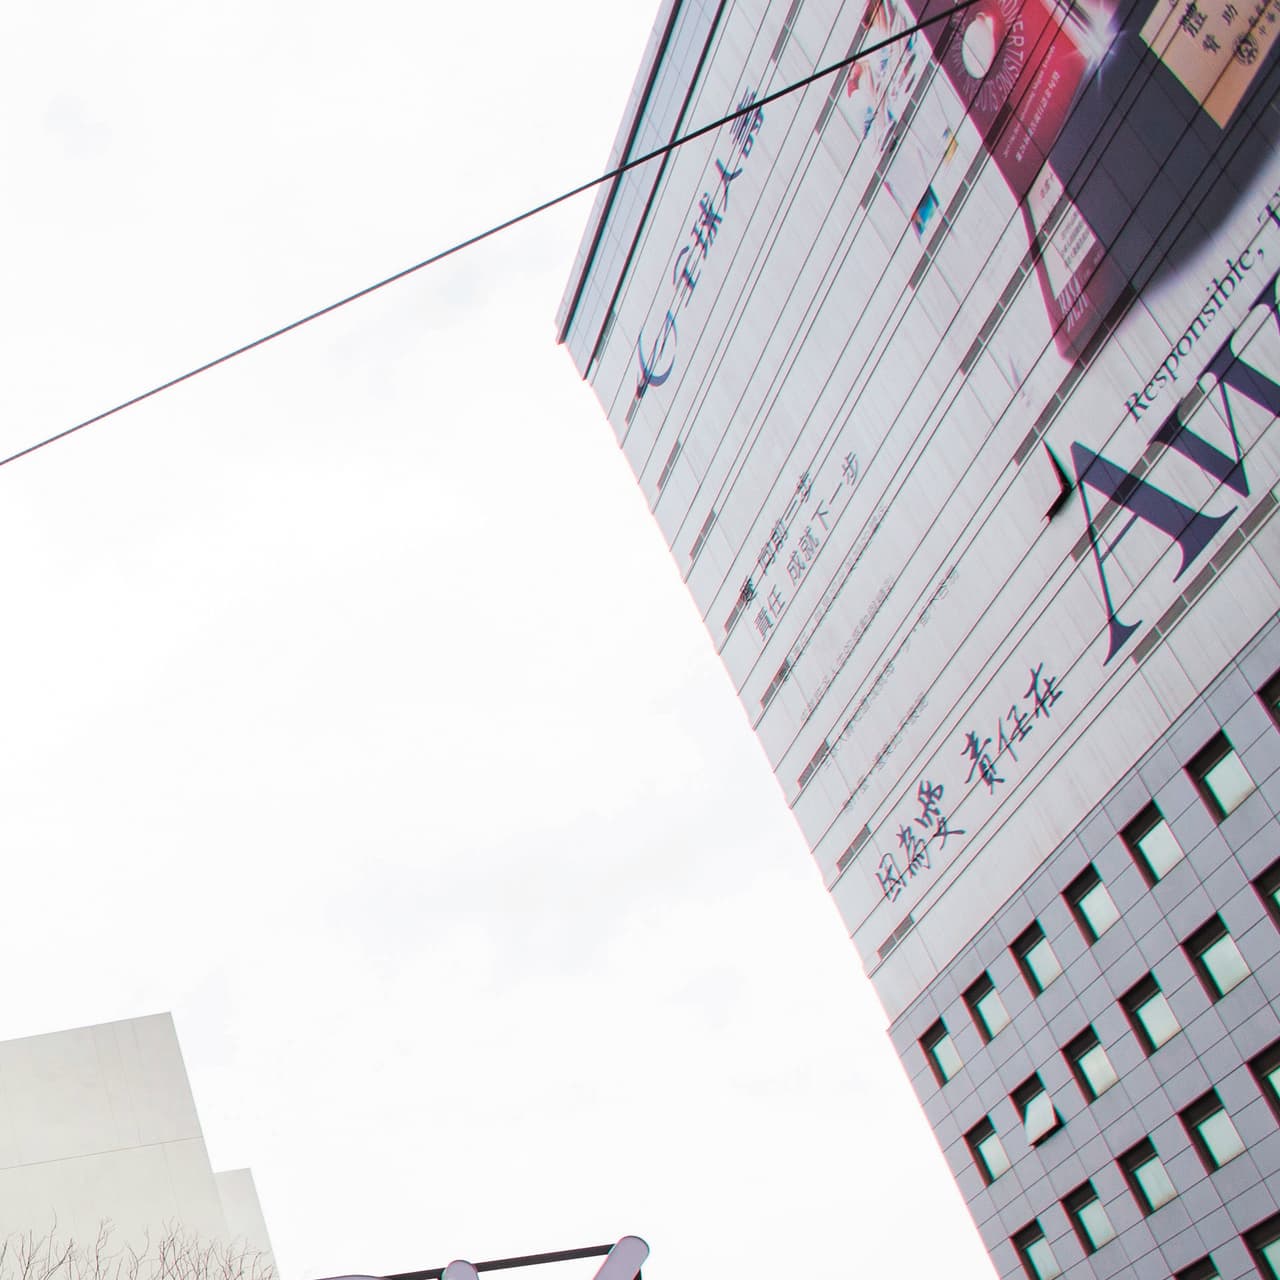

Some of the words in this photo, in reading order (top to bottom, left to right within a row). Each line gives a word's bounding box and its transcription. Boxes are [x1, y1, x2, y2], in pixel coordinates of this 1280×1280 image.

[673, 86, 765, 308] 全球人壽
[1123, 246, 1266, 424] Responsible,
